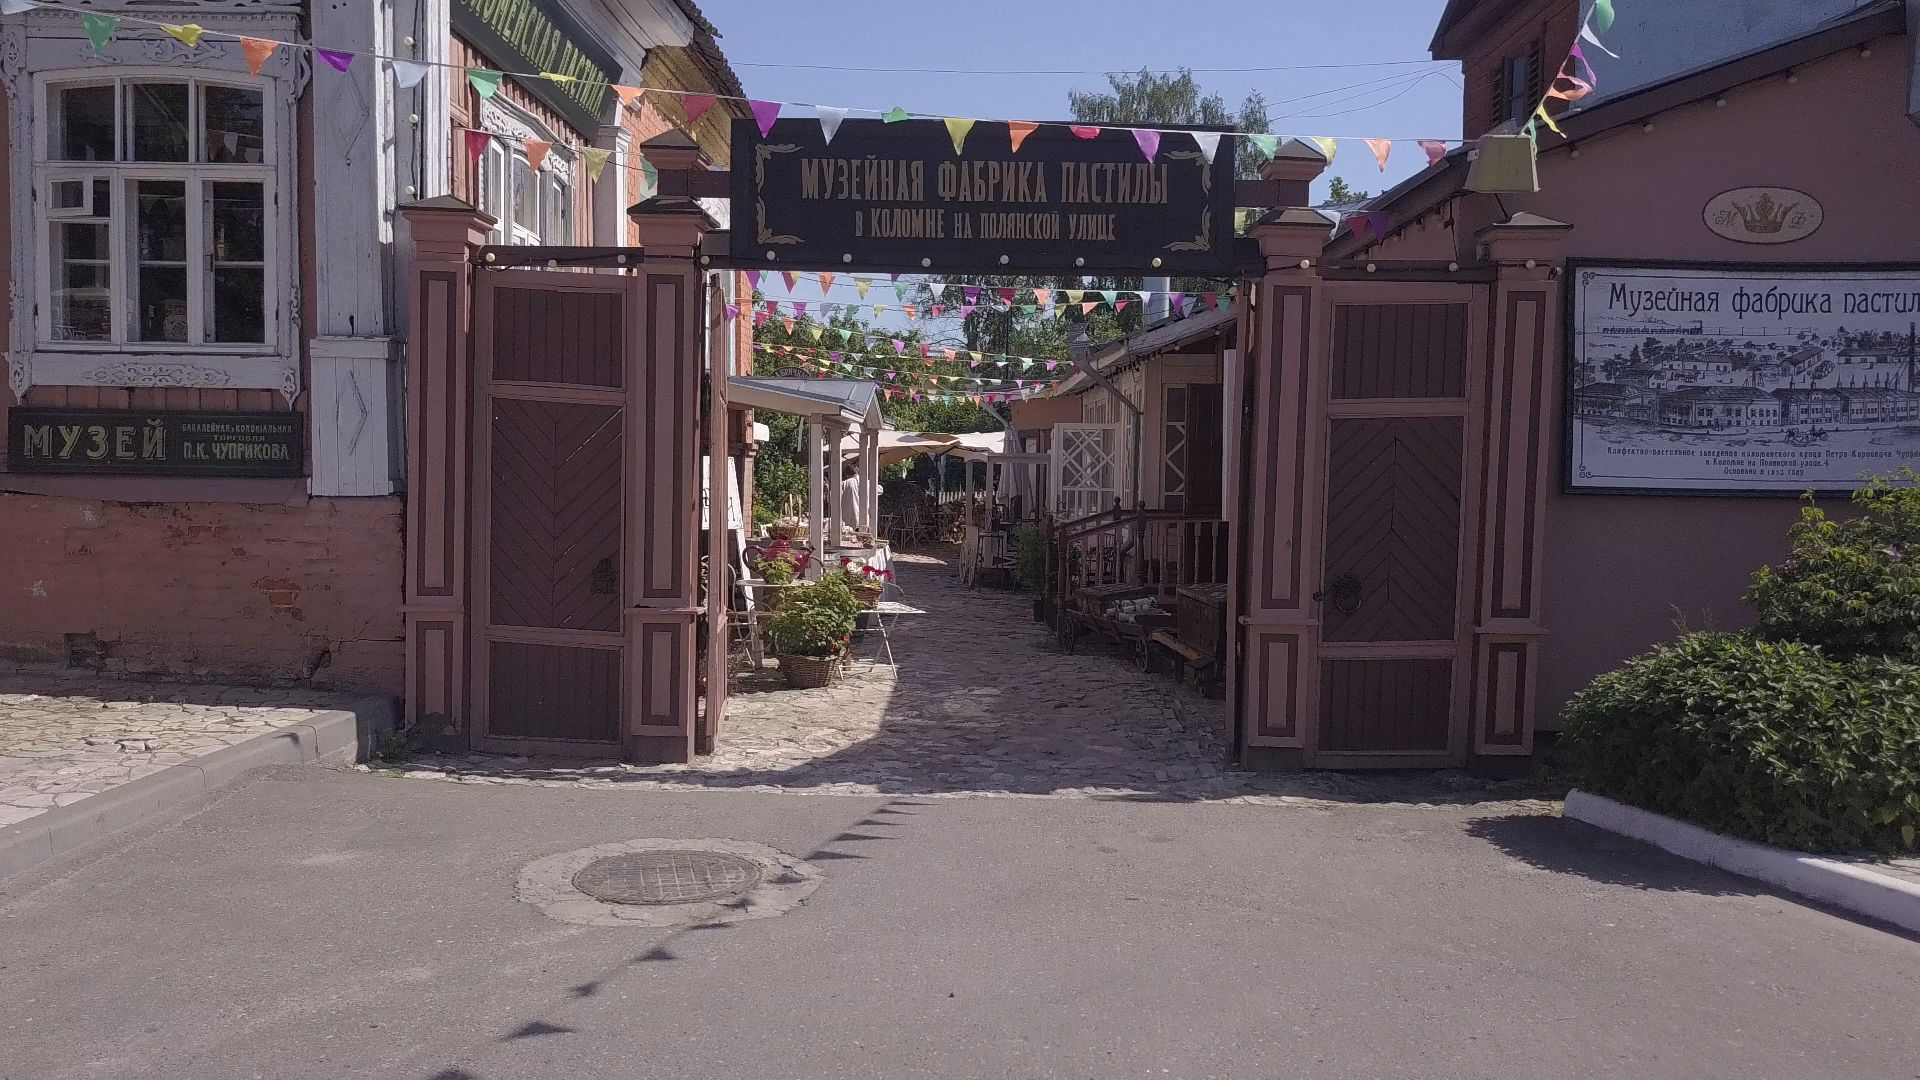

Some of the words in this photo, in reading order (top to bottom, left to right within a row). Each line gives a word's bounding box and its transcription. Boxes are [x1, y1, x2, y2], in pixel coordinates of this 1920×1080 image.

[801, 154, 924, 201] МУЗЕЙНАЯ
[937, 160, 1048, 203] ФАБРИКА
[1061, 162, 1168, 204] ПАСТИЛЫ
[871, 207, 945, 238] КОЛОМНЕ
[954, 212, 972, 239] НА
[980, 211, 1060, 240] ПОЛЯНСКОЙ
[1068, 214, 1116, 242] УЛИЦЕ
[1608, 282, 1720, 318] Музейная
[1731, 285, 1832, 320] фабрика
[23, 418, 167, 461] МУЗЕЙ
[212, 442, 289, 461] ЧУПРИКОВА
[213, 434, 266, 442] ТОРГОВЛЯ
[1713, 458, 1744, 467] Коломне
[1724, 467, 1757, 475] Основано
